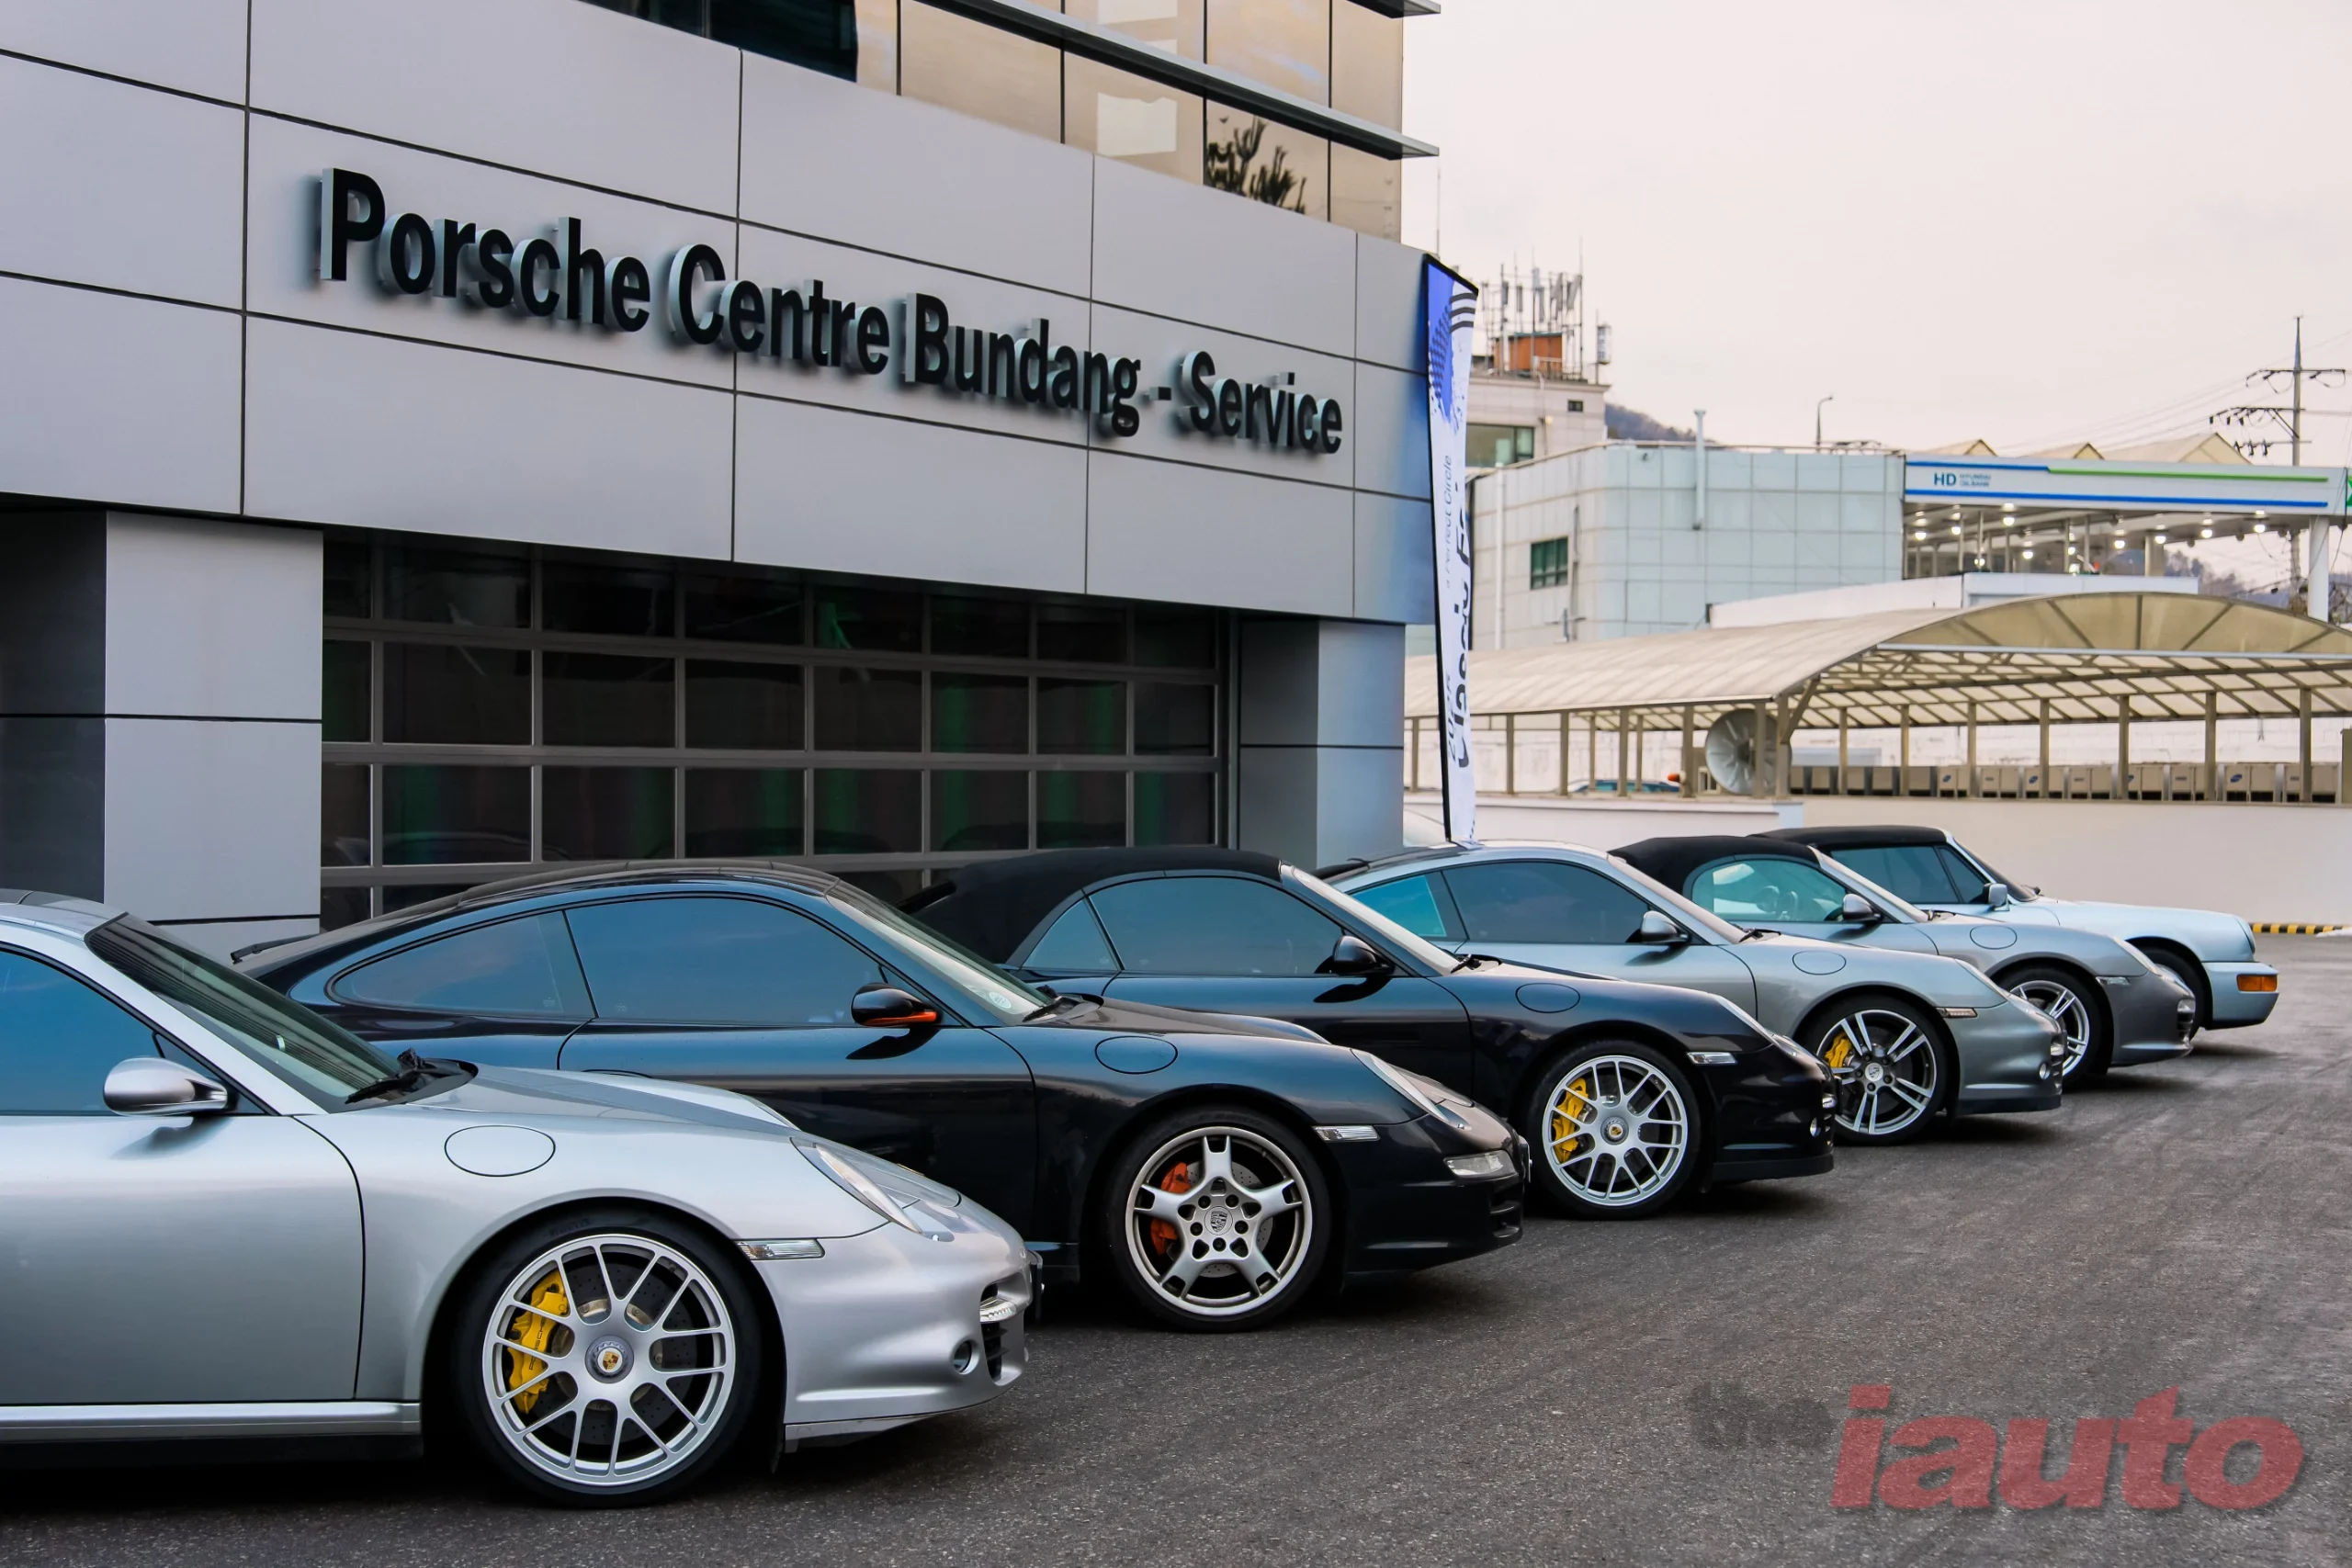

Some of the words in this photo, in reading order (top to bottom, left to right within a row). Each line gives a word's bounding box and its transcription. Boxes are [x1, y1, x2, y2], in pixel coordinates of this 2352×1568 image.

[321, 167, 651, 333] Porsche
[669, 243, 890, 376] Centre
[905, 292, 1141, 437] Bundang
[1182, 350, 1343, 455] Service
[1442, 454, 1453, 505] Circle
[1933, 472, 1957, 487] HD
[528, 1316, 547, 1371] POSCHE
